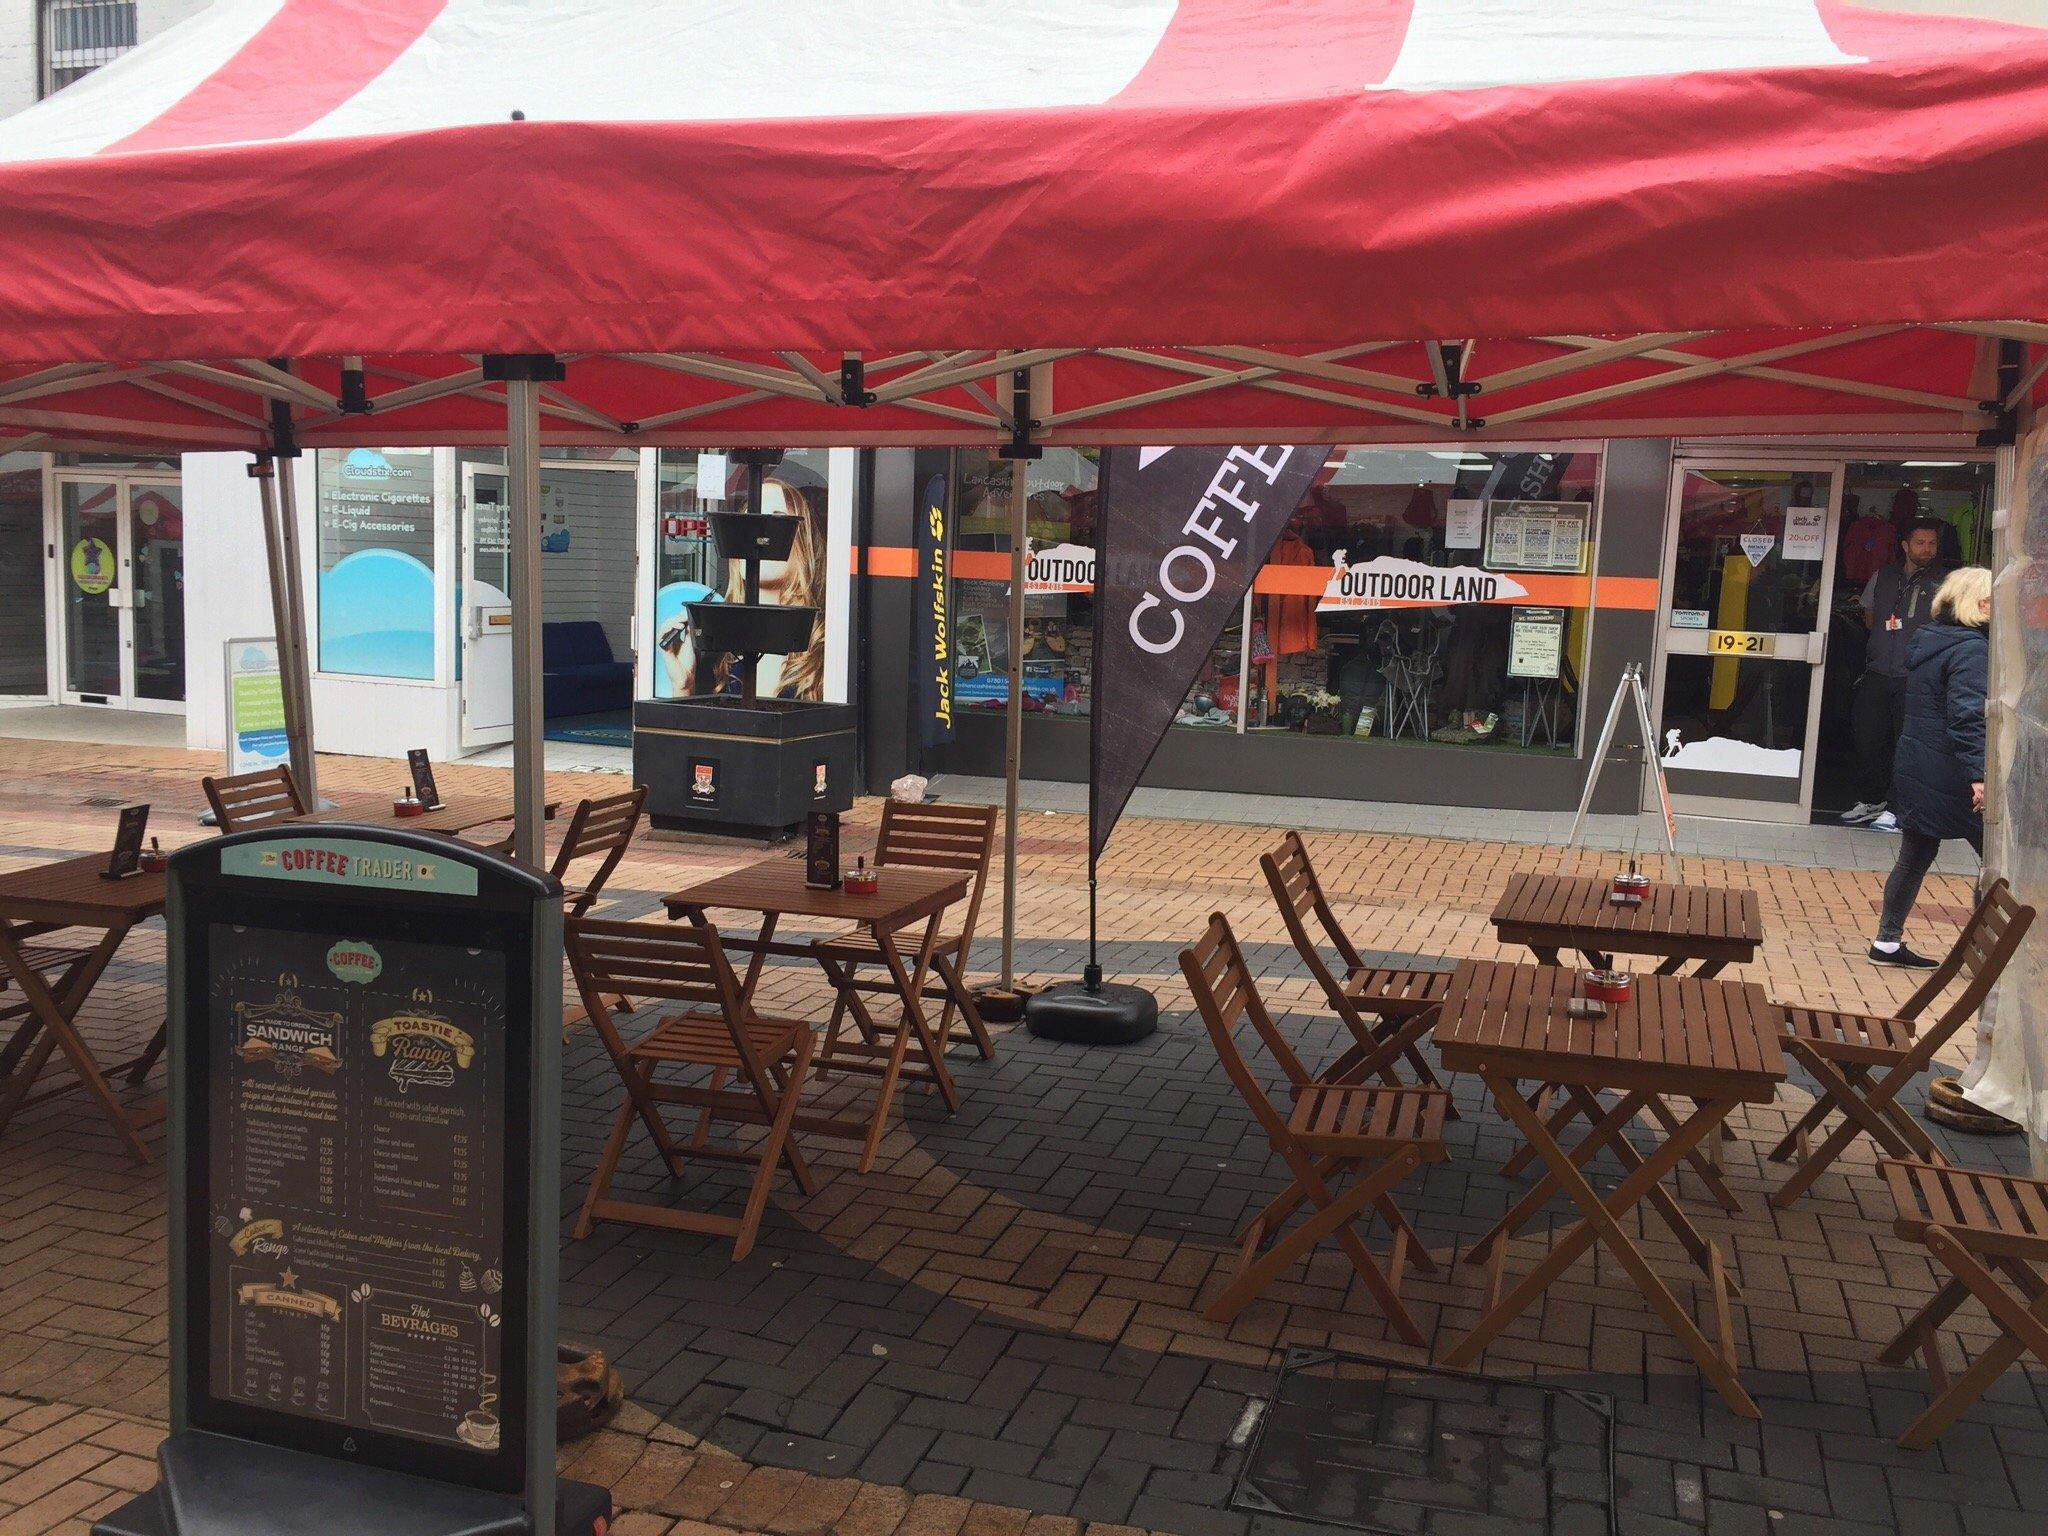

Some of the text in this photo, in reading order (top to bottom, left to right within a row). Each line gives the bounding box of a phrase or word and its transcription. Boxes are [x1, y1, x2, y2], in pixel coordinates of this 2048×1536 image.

[344, 465, 412, 477] Cloudstix.com
[963, 473, 1012, 486] Lancashi
[332, 491, 431, 505] Electronic Cigarettes
[332, 505, 371, 517] E-Liquid
[332, 519, 415, 532] E-Cig Accessories
[660, 519, 711, 538] OPE
[1129, 446, 1295, 654] COFFE
[1028, 558, 1096, 583] OUTDOO
[1340, 571, 1497, 602] OUTDOOR LAND
[931, 548, 951, 730] Jack Wolfskin
[281, 849, 348, 877] COFFEE
[352, 856, 414, 882] TRADER
[332, 951, 376, 969] COFFEE
[246, 1023, 333, 1047] SANDWICH
[393, 1021, 454, 1038] TOASTIE
[271, 1041, 305, 1054] RANGE
[392, 1036, 453, 1069] Range
[252, 1237, 290, 1260] Range
[266, 1294, 315, 1309] CANNED
[272, 1307, 308, 1320] DRINKS
[410, 1304, 431, 1319] Hot
[381, 1313, 459, 1338] BEVRAGES
